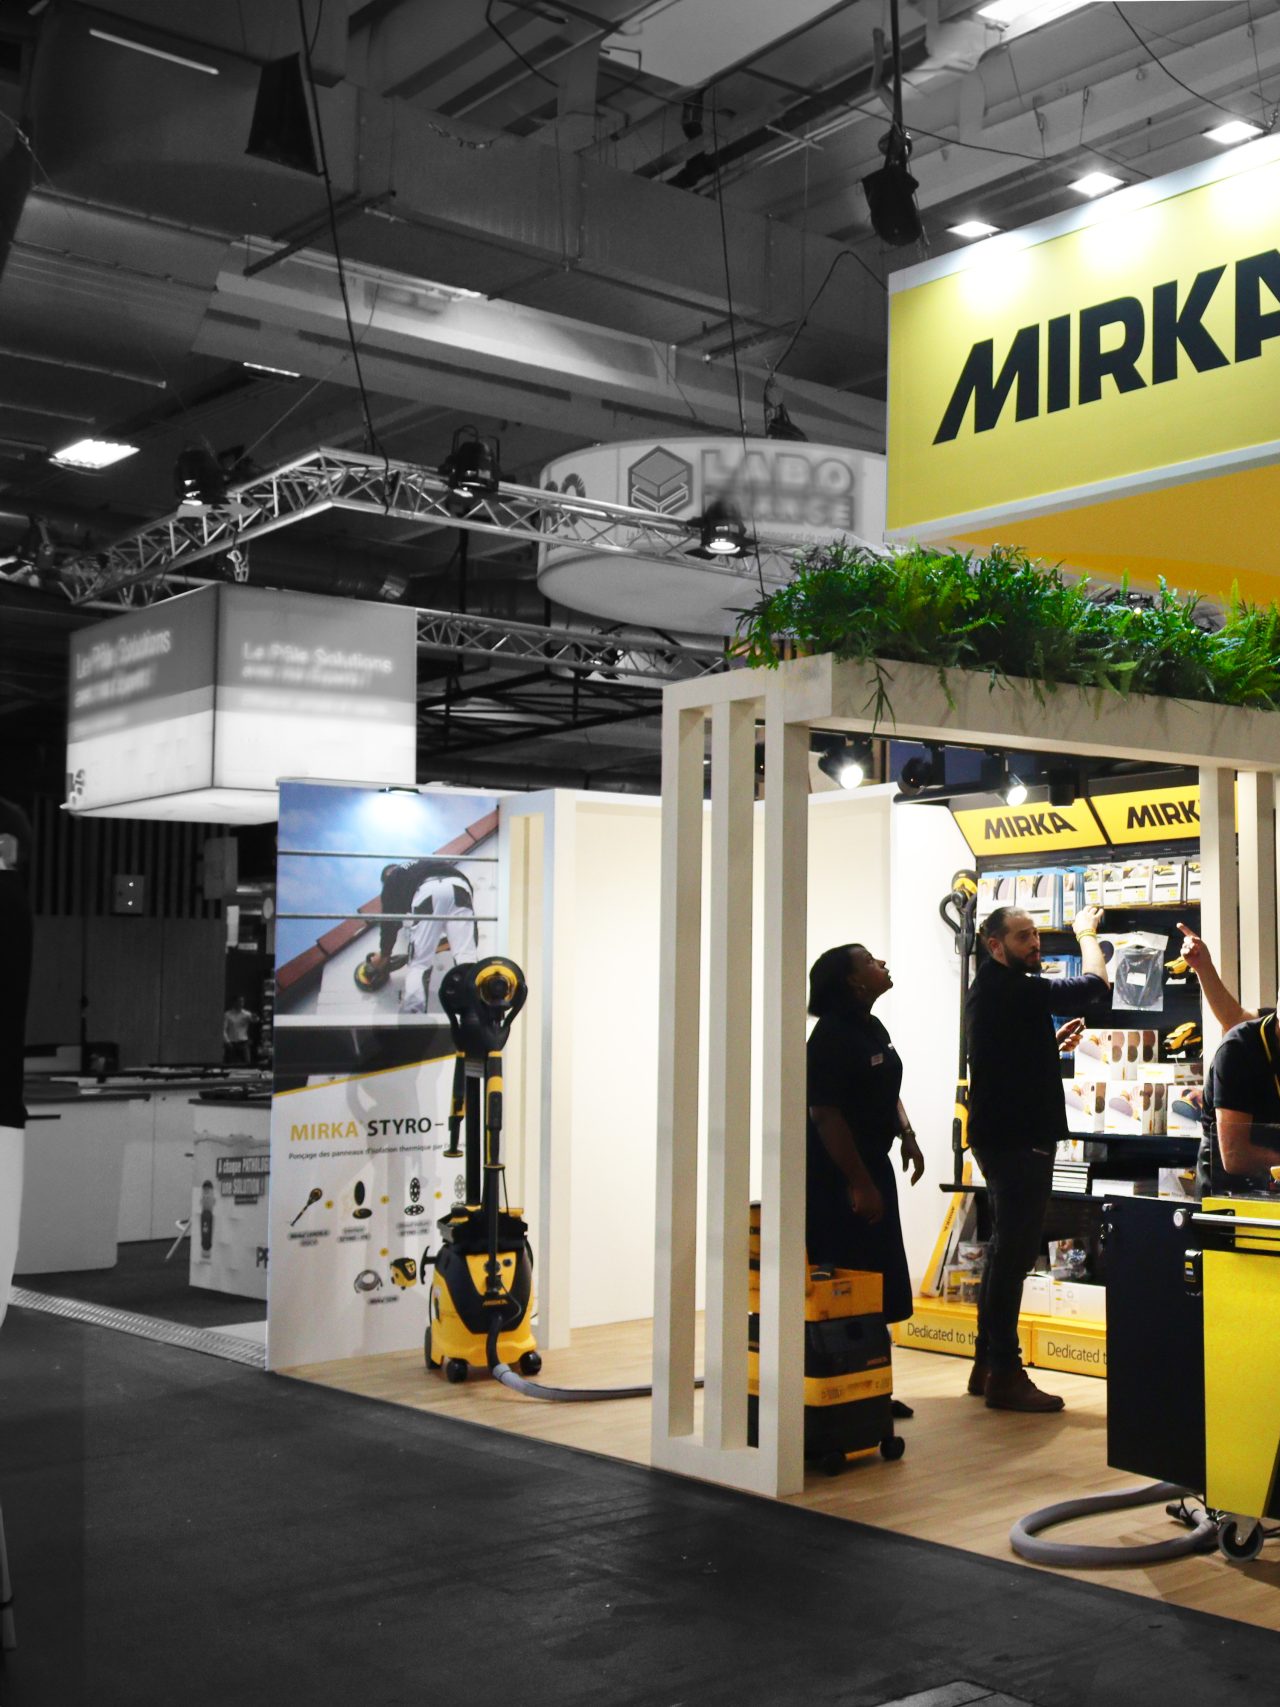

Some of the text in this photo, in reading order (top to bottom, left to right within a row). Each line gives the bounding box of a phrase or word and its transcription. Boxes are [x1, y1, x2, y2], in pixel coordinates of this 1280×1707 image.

[313, 648, 393, 674] Solutions
[984, 812, 1078, 840] MIRKA
[1127, 800, 1200, 829] MIRK
[290, 1121, 359, 1142] MIRKA
[367, 1117, 432, 1137] STYRO
[319, 1150, 330, 1158] des
[331, 1148, 364, 1158] panneaux
[399, 1143, 431, 1153] thermique
[907, 1323, 953, 1342] Dedicated
[956, 1333, 966, 1345] to
[1047, 1341, 1100, 1363] Dedicated
